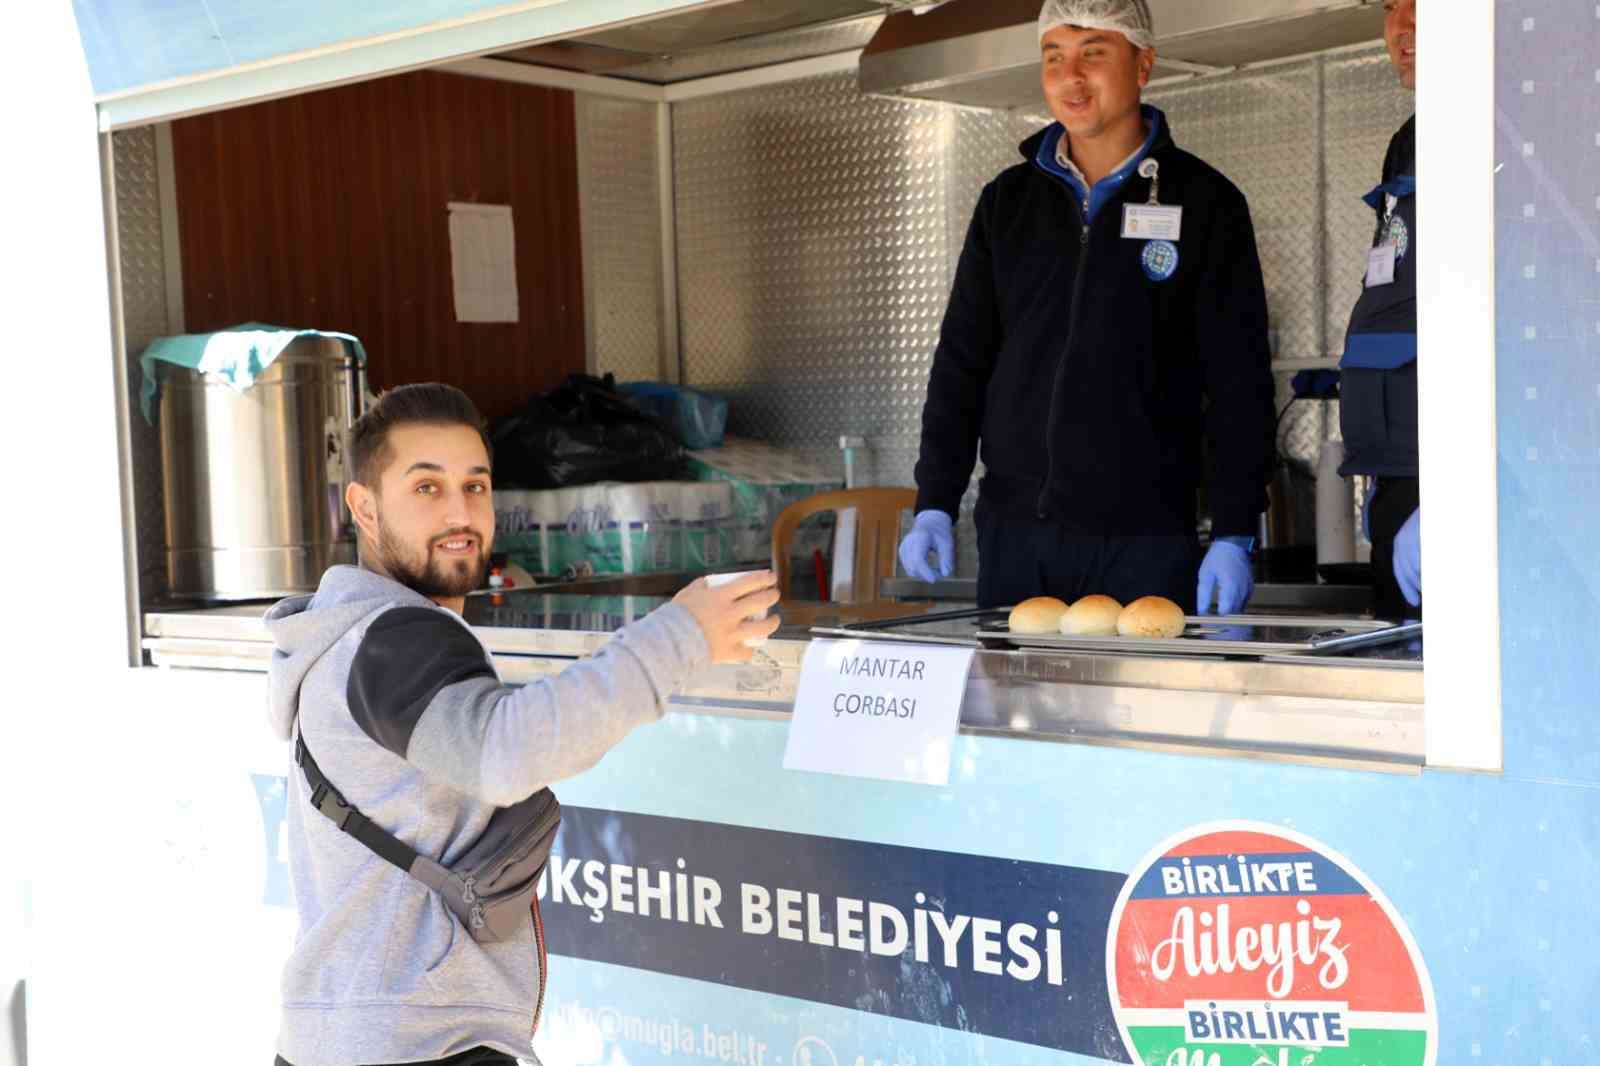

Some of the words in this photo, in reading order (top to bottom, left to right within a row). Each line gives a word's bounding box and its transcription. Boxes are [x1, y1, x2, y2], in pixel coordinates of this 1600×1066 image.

[839, 656, 926, 681] MANTAR
[833, 692, 917, 719] ÇORBASI
[1161, 855, 1318, 896] BİRLİKTE
[741, 882, 1063, 986] BELEDİYESİ
[1151, 900, 1350, 998] Aileyiz
[1188, 1002, 1346, 1041] BİRLİKTE
